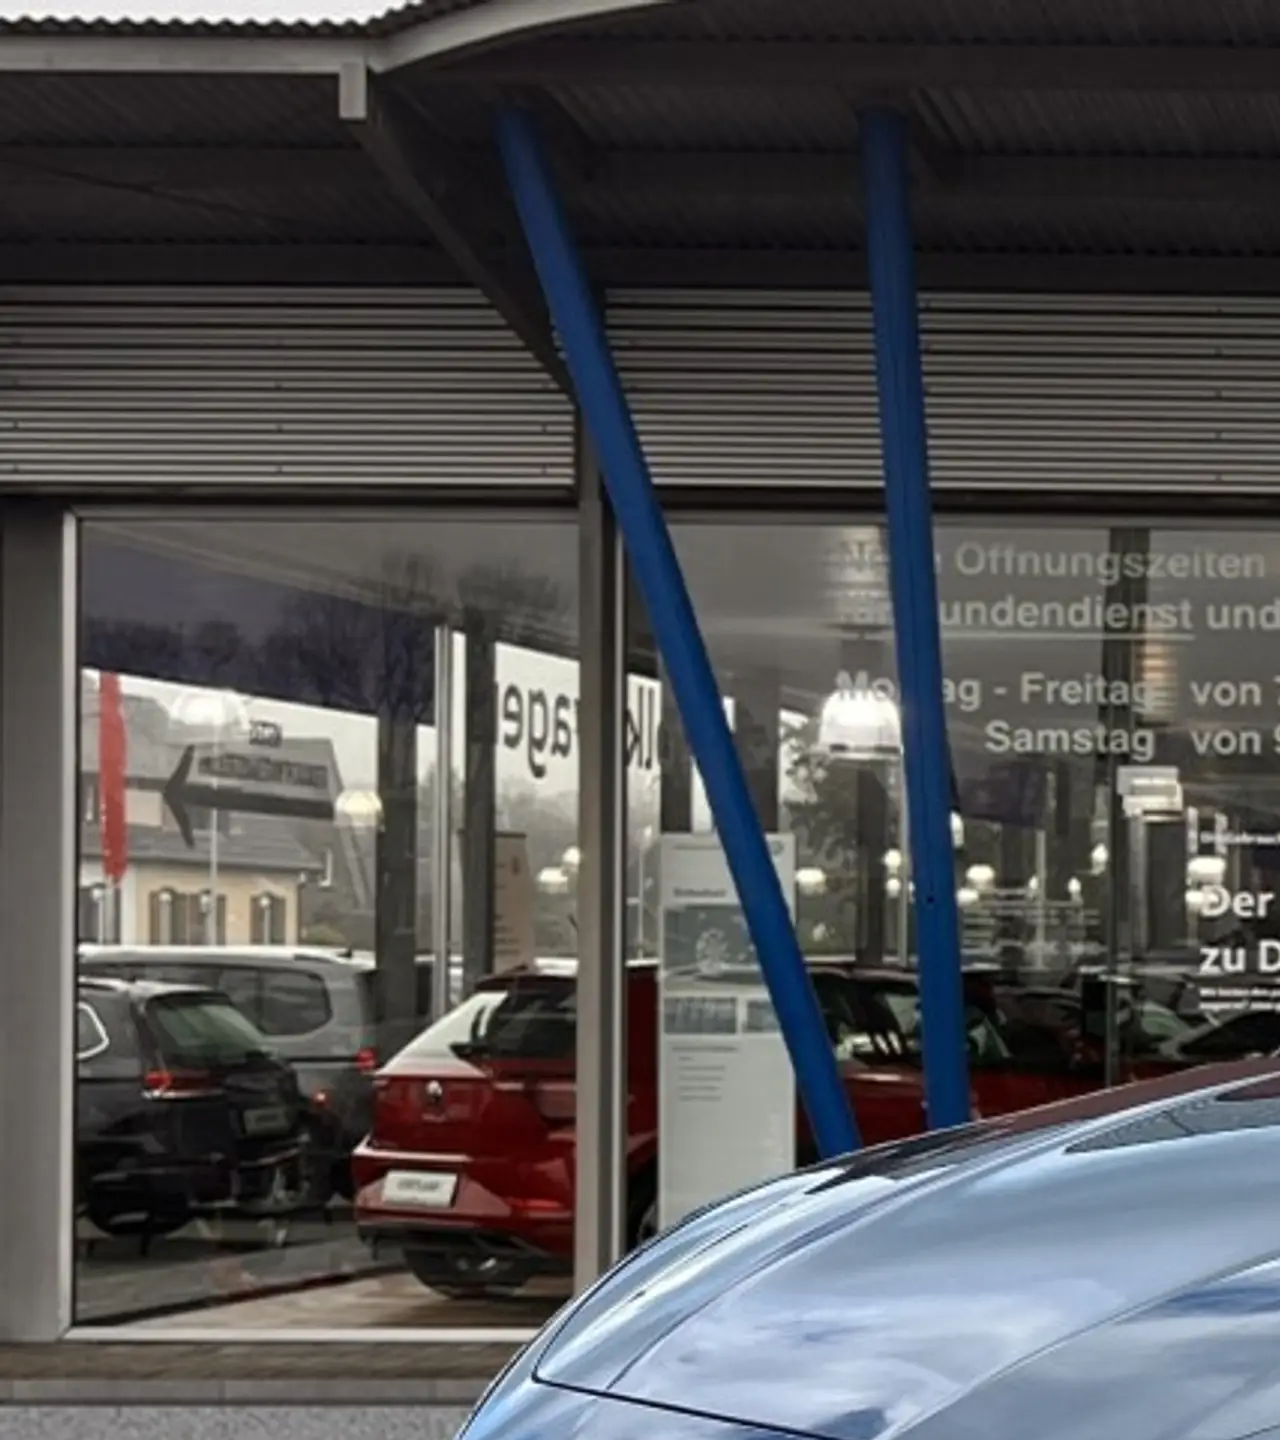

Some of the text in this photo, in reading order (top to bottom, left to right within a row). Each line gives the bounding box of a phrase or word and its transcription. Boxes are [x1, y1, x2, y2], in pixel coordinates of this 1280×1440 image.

[940, 594, 1194, 630] undendienst
[1020, 670, 1154, 714] Freitag
[1190, 681, 1262, 706] von
[984, 721, 1155, 762] Samstag
[1190, 729, 1262, 755] von
[1199, 884, 1275, 918] Der
[1200, 946, 1246, 974] zu
